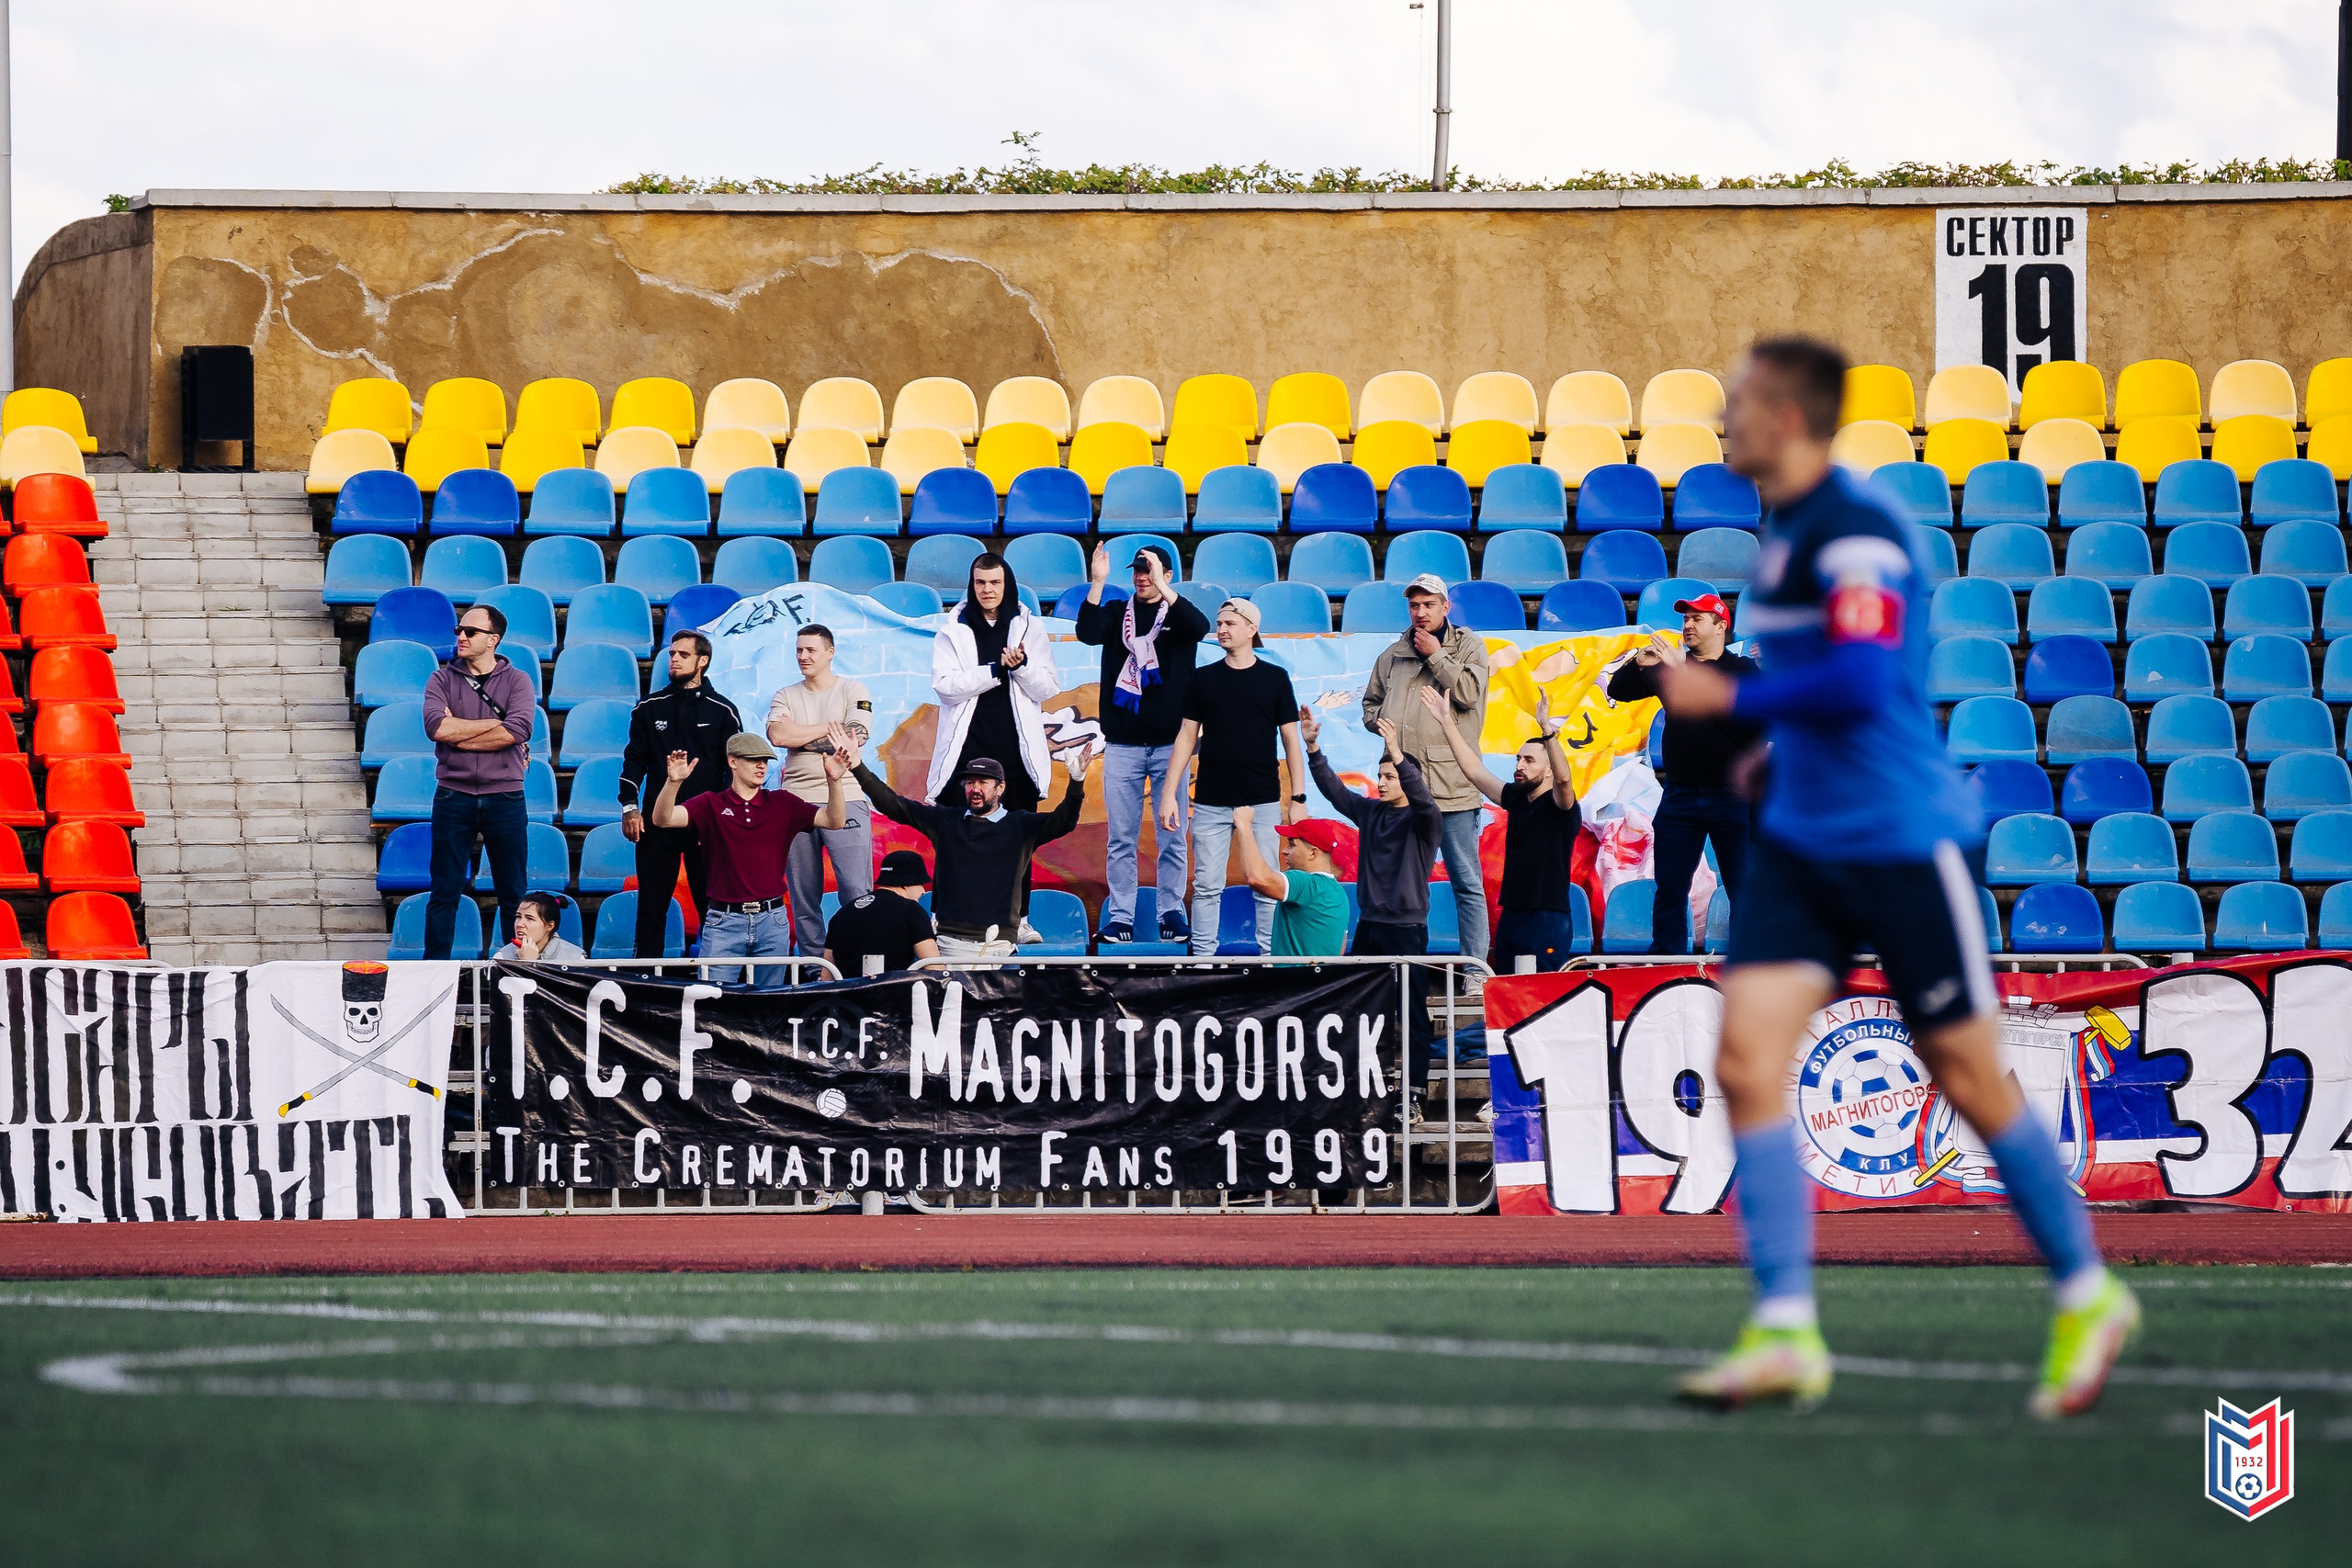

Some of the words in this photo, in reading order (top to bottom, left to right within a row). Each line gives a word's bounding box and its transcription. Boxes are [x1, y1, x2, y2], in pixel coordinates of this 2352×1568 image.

[1947, 216, 2075, 257] СЕКТОР
[1968, 263, 2076, 393] 19
[498, 976, 752, 1104] T.C.F.
[787, 1017, 888, 1060] T.C.F.
[910, 980, 1387, 1104] MAGNITOGORSK
[1503, 978, 1737, 1215] 19
[2140, 958, 2352, 1198] 32
[496, 1127, 592, 1183] THE
[634, 1128, 1001, 1188] CREMATORIUM
[1040, 1131, 1172, 1188] FANS
[1217, 1127, 1388, 1186] 1999
